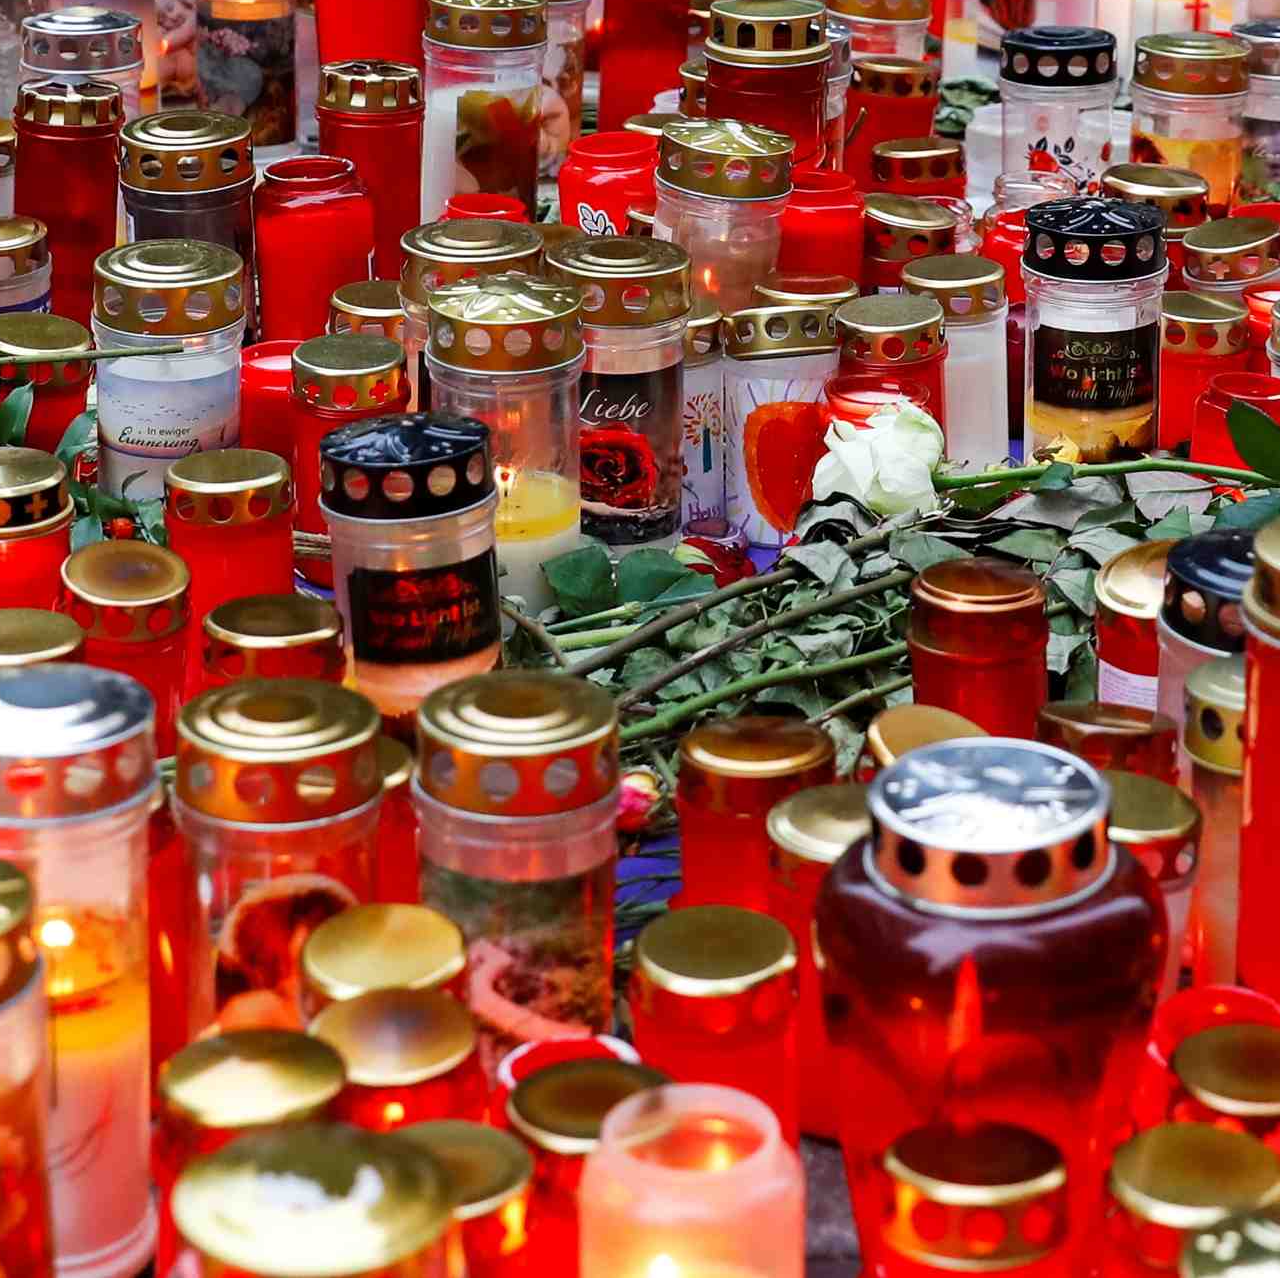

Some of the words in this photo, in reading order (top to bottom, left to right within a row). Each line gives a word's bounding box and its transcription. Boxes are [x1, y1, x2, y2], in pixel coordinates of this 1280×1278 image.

[579, 389, 651, 426] Liebe
[147, 426, 157, 435] In
[159, 427, 191, 437] ewiger
